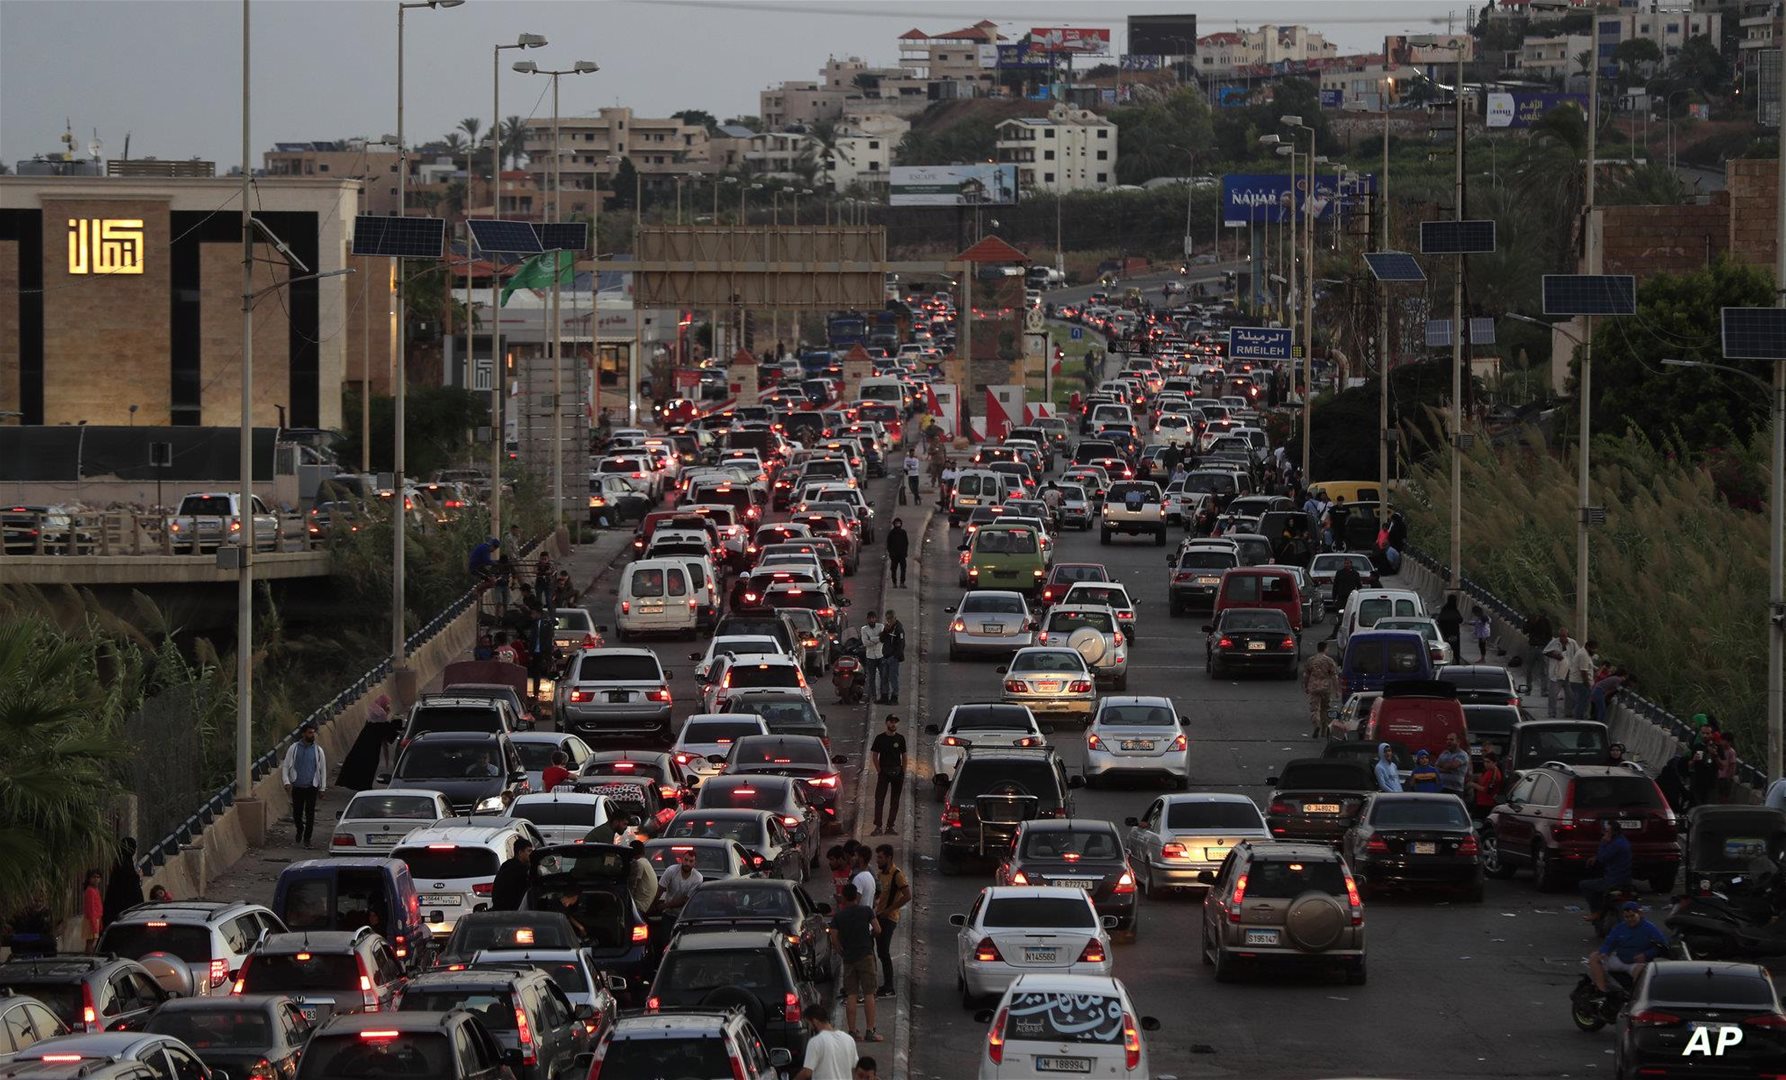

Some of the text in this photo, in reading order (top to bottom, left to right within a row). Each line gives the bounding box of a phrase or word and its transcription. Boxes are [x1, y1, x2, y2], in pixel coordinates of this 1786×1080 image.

[1231, 193, 1277, 207] NAJJAR
[1236, 330, 1284, 344] الرميلة
[1236, 345, 1285, 356] RMEILEH
[1055, 1059, 1084, 1070] 188994
